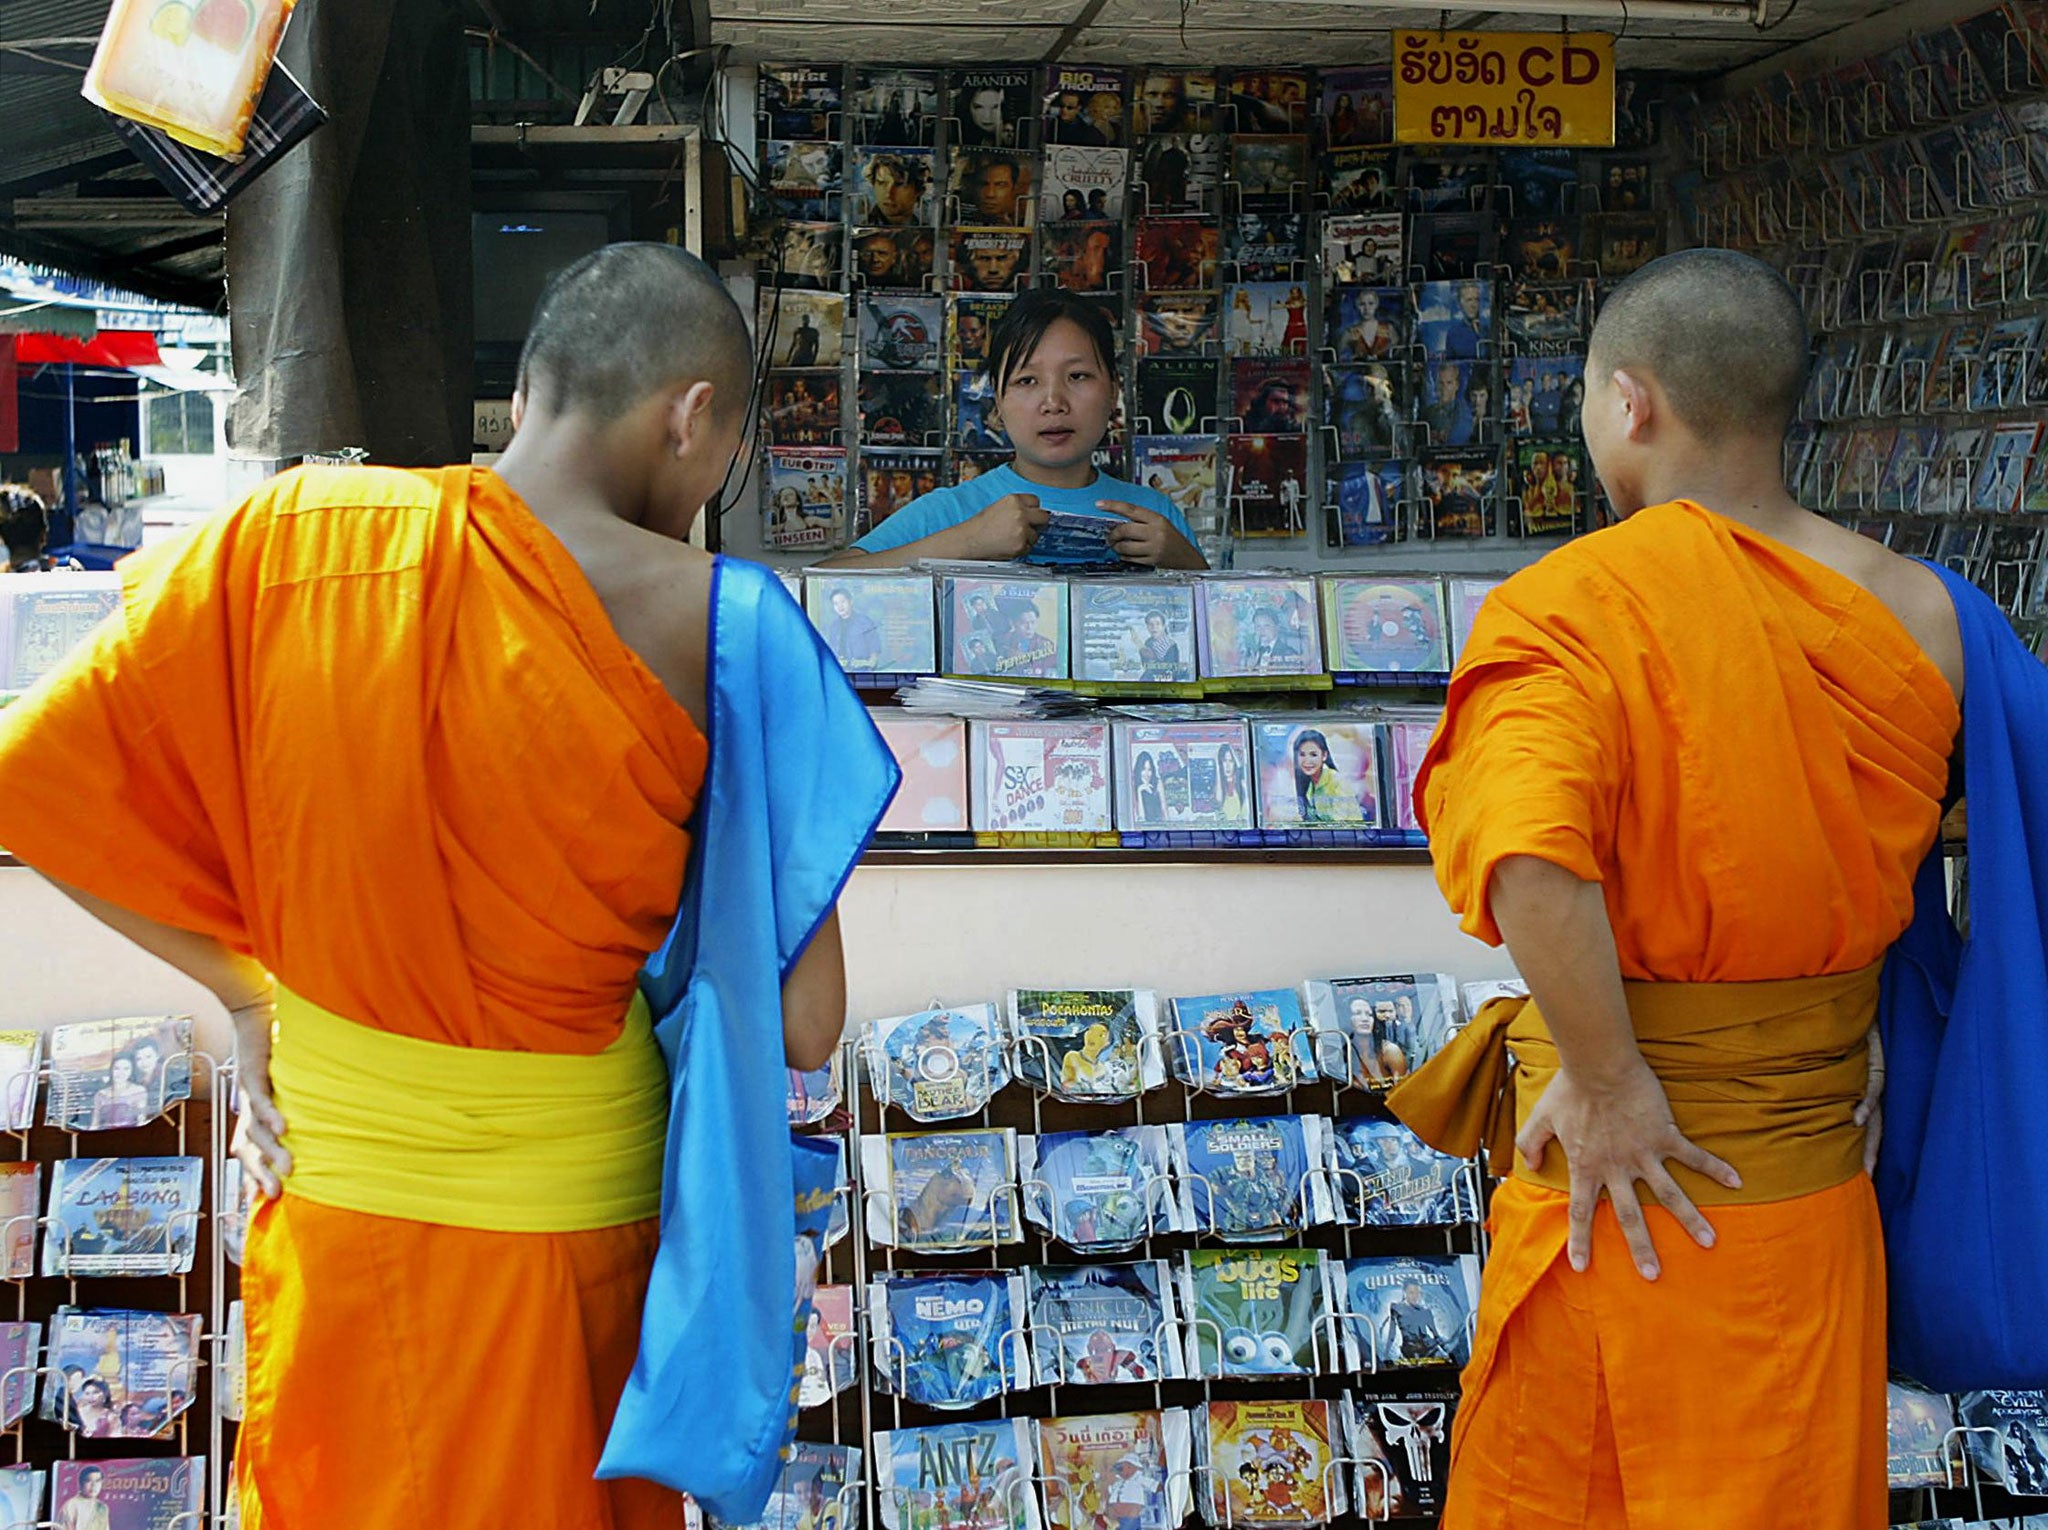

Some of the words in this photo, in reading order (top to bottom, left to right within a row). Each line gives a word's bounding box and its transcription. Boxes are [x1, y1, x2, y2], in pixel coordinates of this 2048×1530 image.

[1401, 36, 1505, 85] ຮັບອັດ
[1518, 46, 1600, 87] CD
[963, 75, 1028, 87] ABANDON
[1060, 72, 1094, 84] BIG
[1061, 82, 1122, 91] TROUBLE
[1431, 88, 1562, 139] ຕາມໃຈ
[1150, 361, 1215, 370] ALIEN
[774, 531, 823, 545] UNSEEN
[1006, 777, 1044, 807] DANCE
[1042, 1001, 1113, 1016] POCAHONTAS
[1209, 1138, 1281, 1153] SOLDIERS
[76, 1190, 121, 1206] LAO
[126, 1189, 180, 1212] SONG
[1215, 1253, 1299, 1287] bug's
[1241, 1281, 1280, 1300] life
[916, 1298, 984, 1317] NEMO
[919, 1433, 997, 1488] ANTZ
